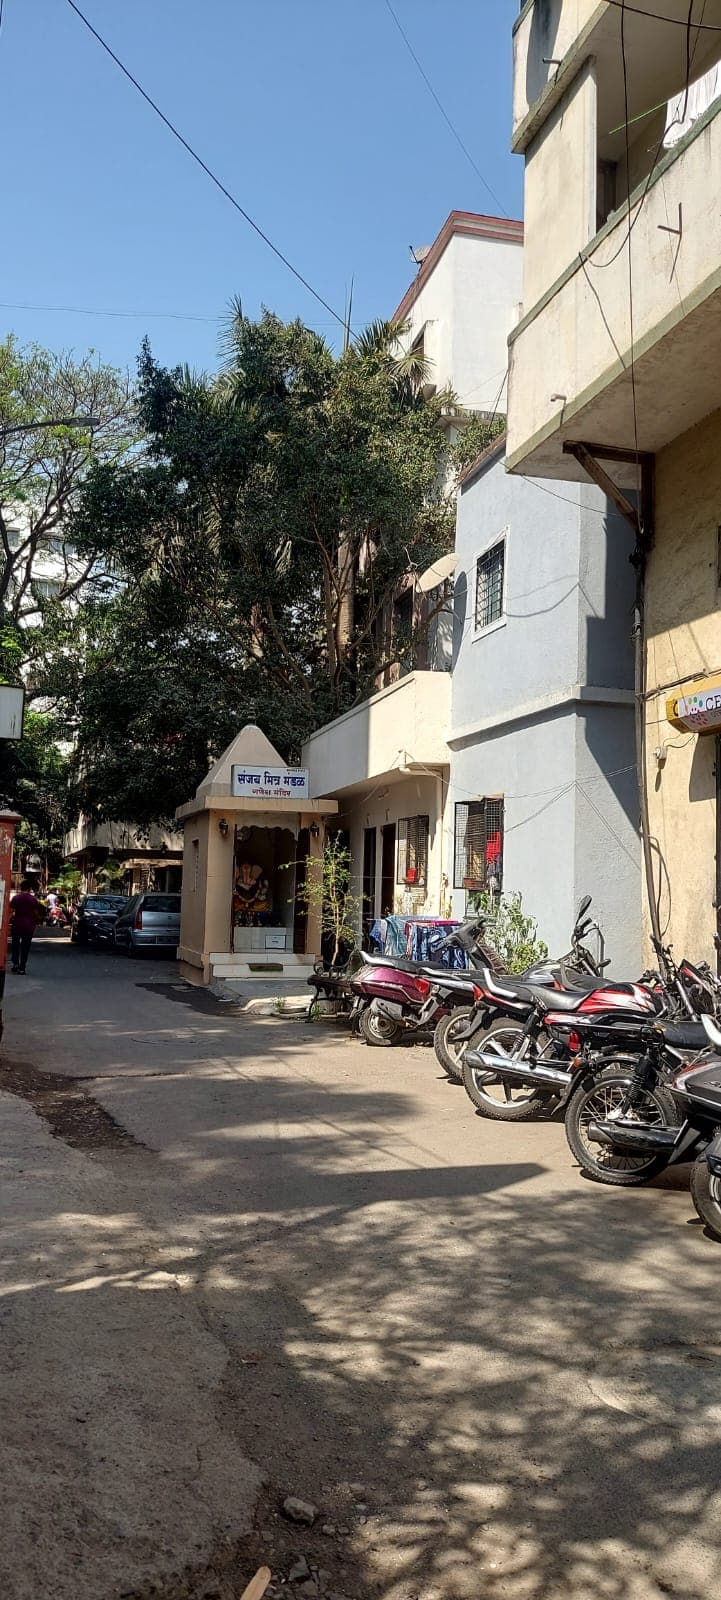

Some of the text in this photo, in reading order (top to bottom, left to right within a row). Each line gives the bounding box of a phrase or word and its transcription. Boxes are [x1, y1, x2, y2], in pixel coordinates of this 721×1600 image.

[237, 770, 305, 787] संजय मित्र मंडळ
